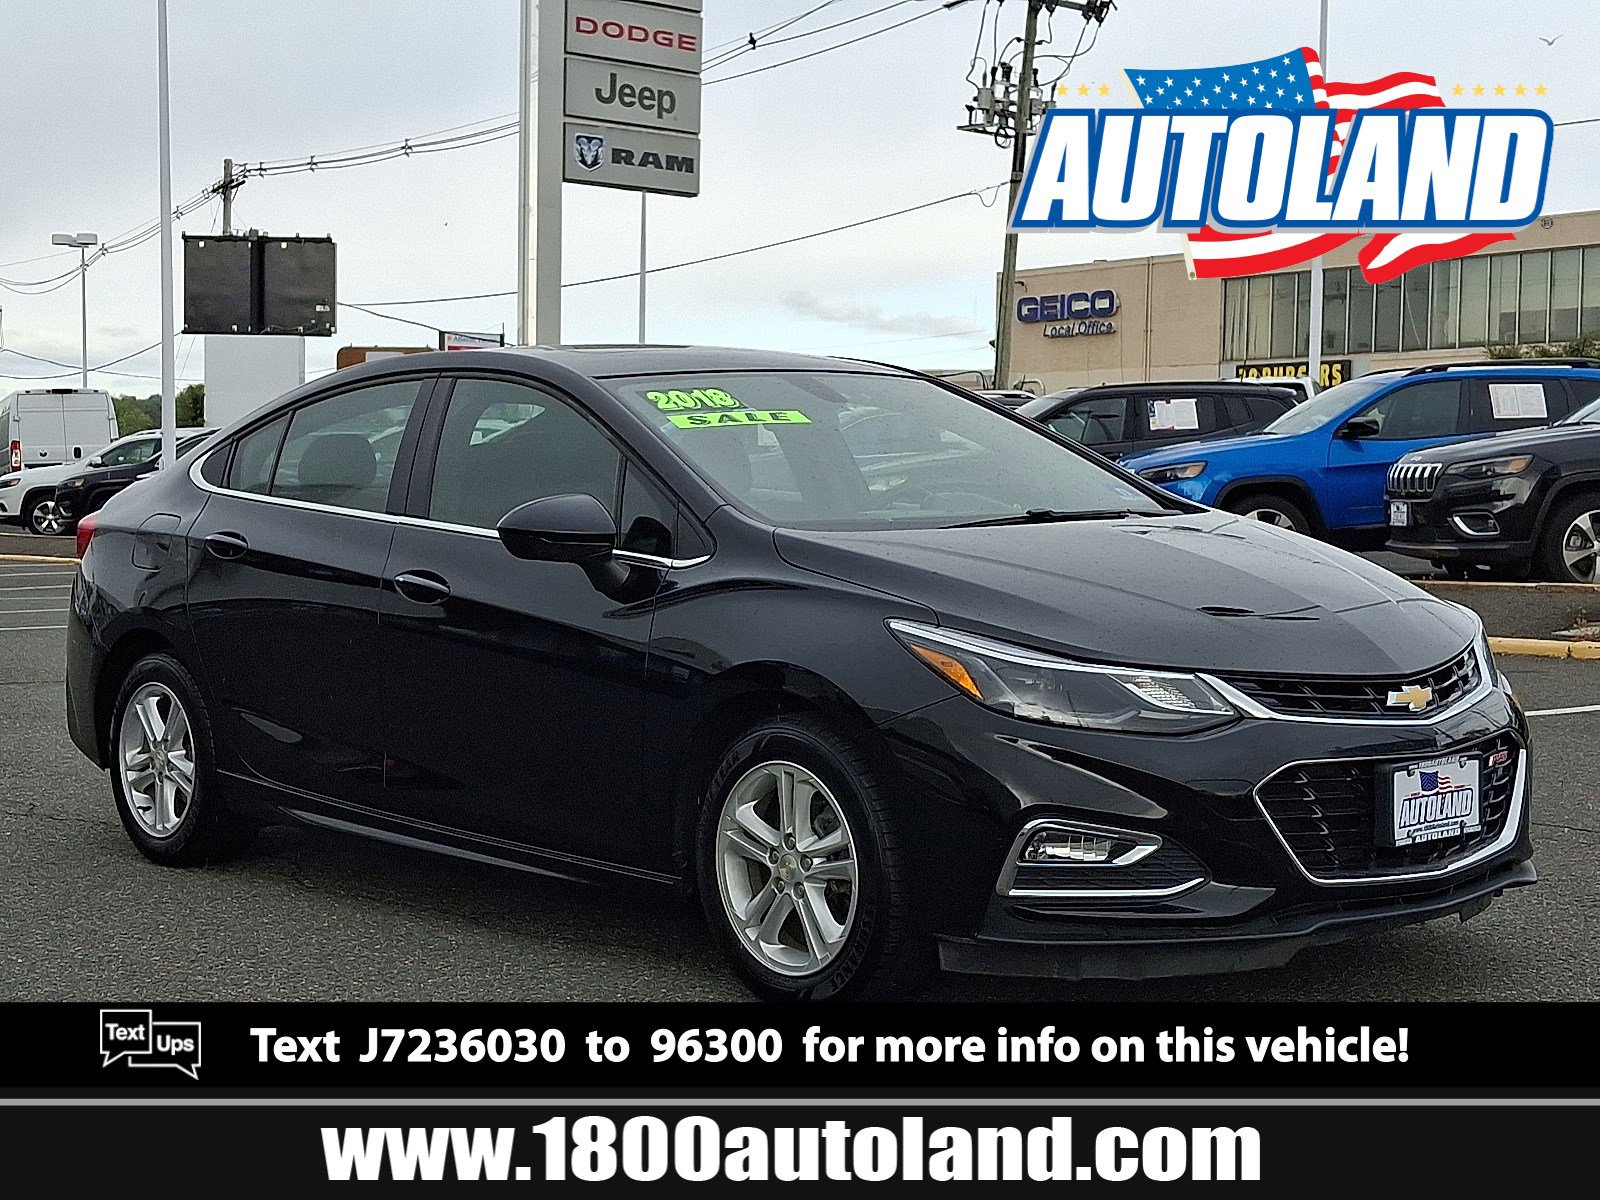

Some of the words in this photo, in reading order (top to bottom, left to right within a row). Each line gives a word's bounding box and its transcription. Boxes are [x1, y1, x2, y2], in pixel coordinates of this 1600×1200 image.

[575, 15, 698, 52] DODGE
[594, 71, 677, 120] Jeep
[610, 147, 695, 174] RAM
[1016, 289, 1116, 323] GEICO
[1042, 321, 1077, 337] Local
[1077, 320, 1114, 336] Office
[646, 387, 741, 412] 2018
[686, 411, 792, 426] SALE
[1399, 787, 1474, 829] AUTOLAND
[1414, 828, 1461, 844] AUTOLAND
